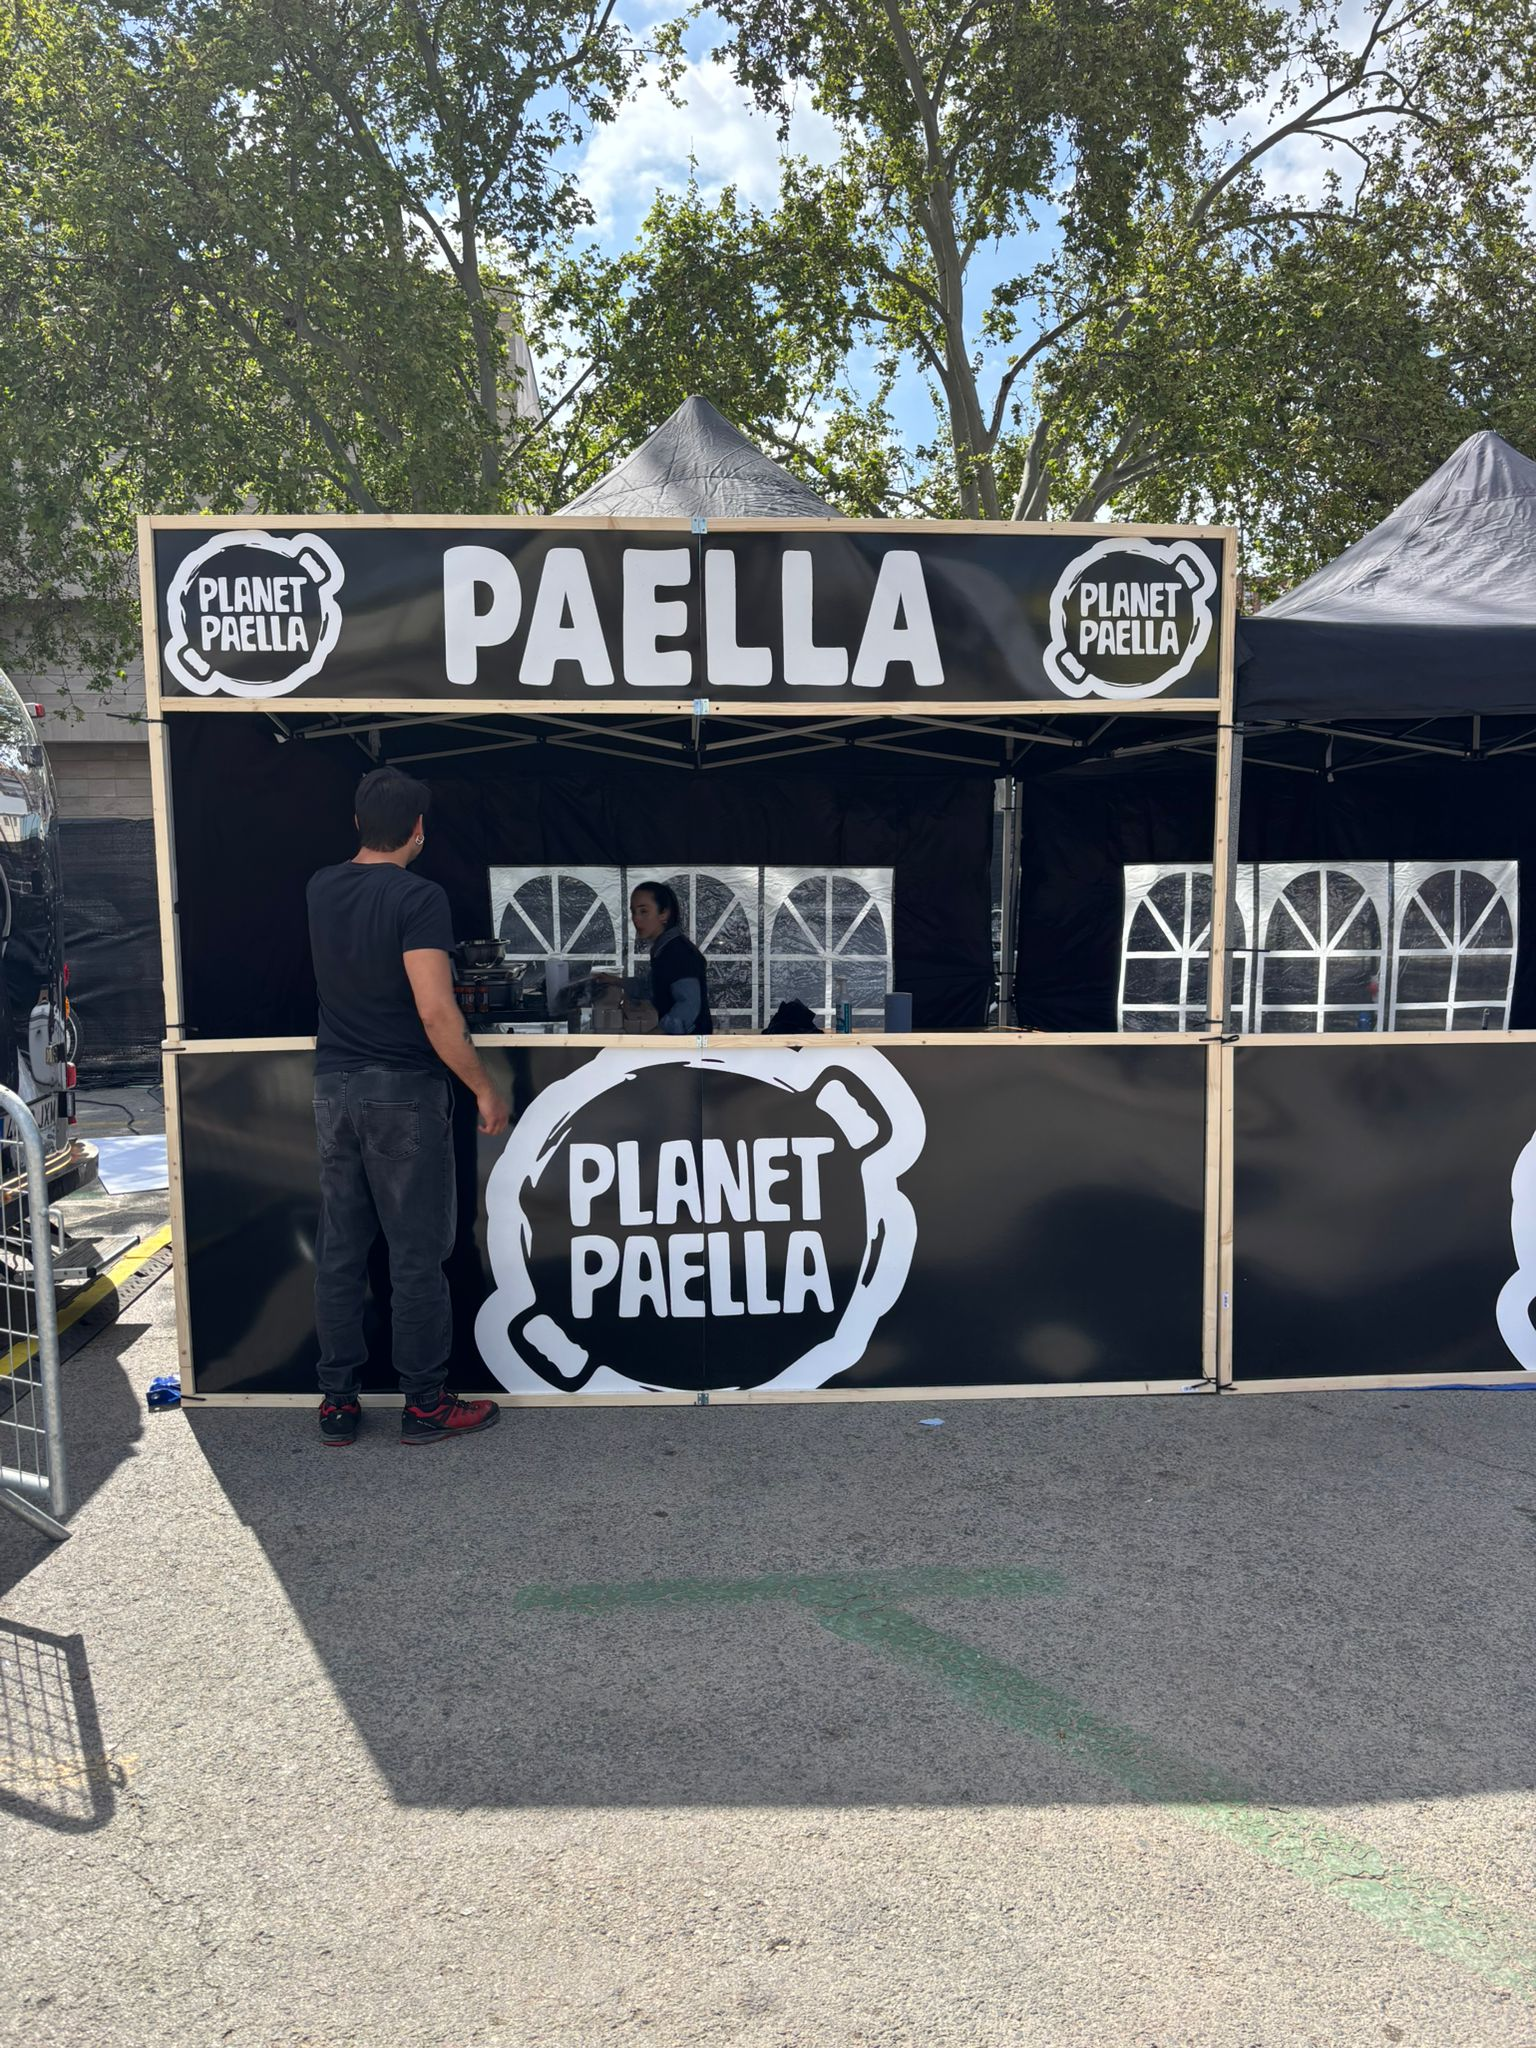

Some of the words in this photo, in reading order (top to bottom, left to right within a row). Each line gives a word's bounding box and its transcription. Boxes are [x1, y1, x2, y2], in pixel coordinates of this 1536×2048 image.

[198, 576, 308, 613] PLANET
[1080, 582, 1182, 618] PLANET
[200, 615, 310, 652] PAELLA
[443, 545, 945, 688] PAELLA
[1079, 619, 1180, 656] PAELLA
[569, 1136, 836, 1227] PLANET
[570, 1230, 835, 1319] PAELLA
